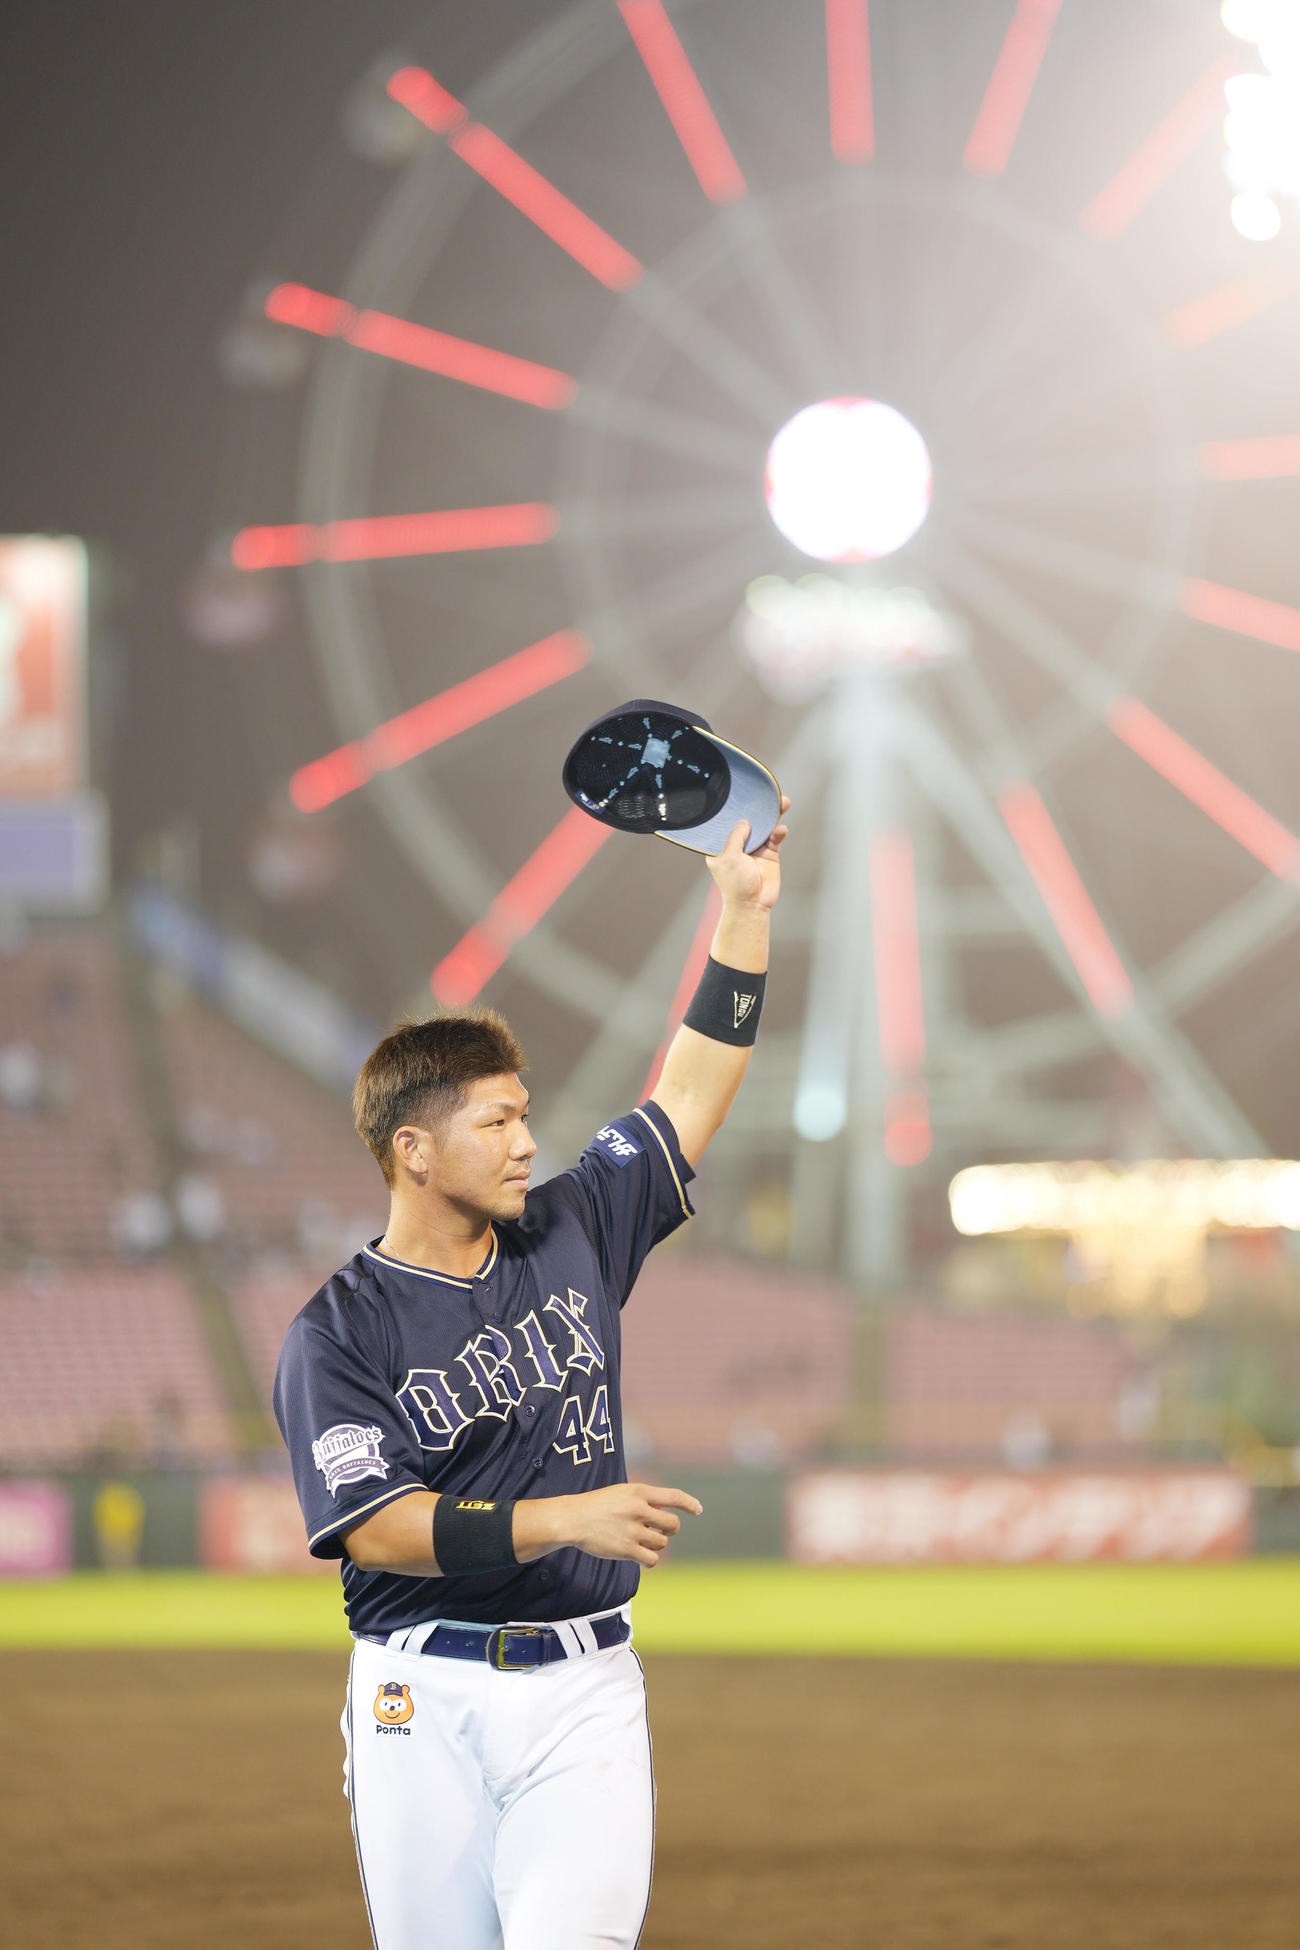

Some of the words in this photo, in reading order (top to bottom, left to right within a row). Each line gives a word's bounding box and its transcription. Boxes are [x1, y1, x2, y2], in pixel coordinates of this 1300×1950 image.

[395, 1287, 605, 1452] ORIX
[312, 1427, 383, 1470] Buffaloes
[552, 1385, 615, 1465] 44
[376, 1724, 411, 1736] Ponta
